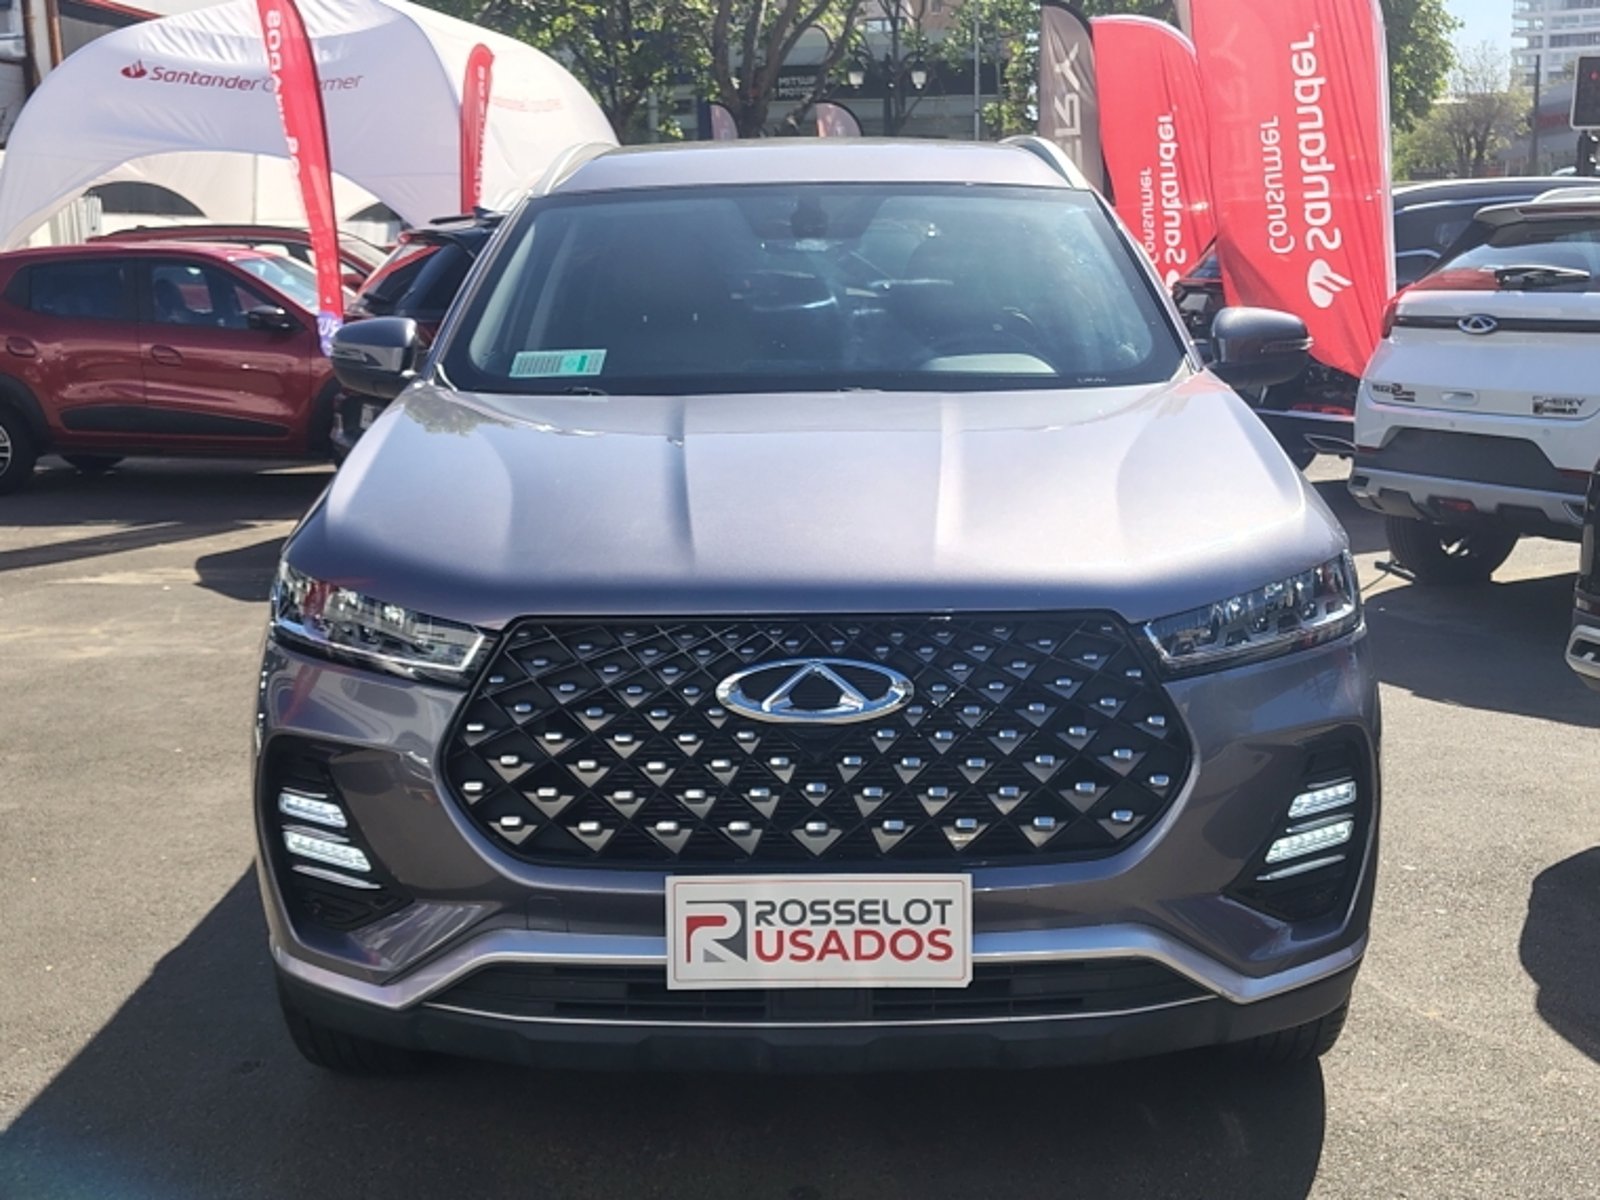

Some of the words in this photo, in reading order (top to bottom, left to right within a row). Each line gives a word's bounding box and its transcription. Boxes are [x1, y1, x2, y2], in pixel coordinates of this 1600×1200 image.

[149, 66, 260, 91] Santander
[755, 899, 953, 926] ROSSELOT
[755, 929, 954, 962] USADOS
